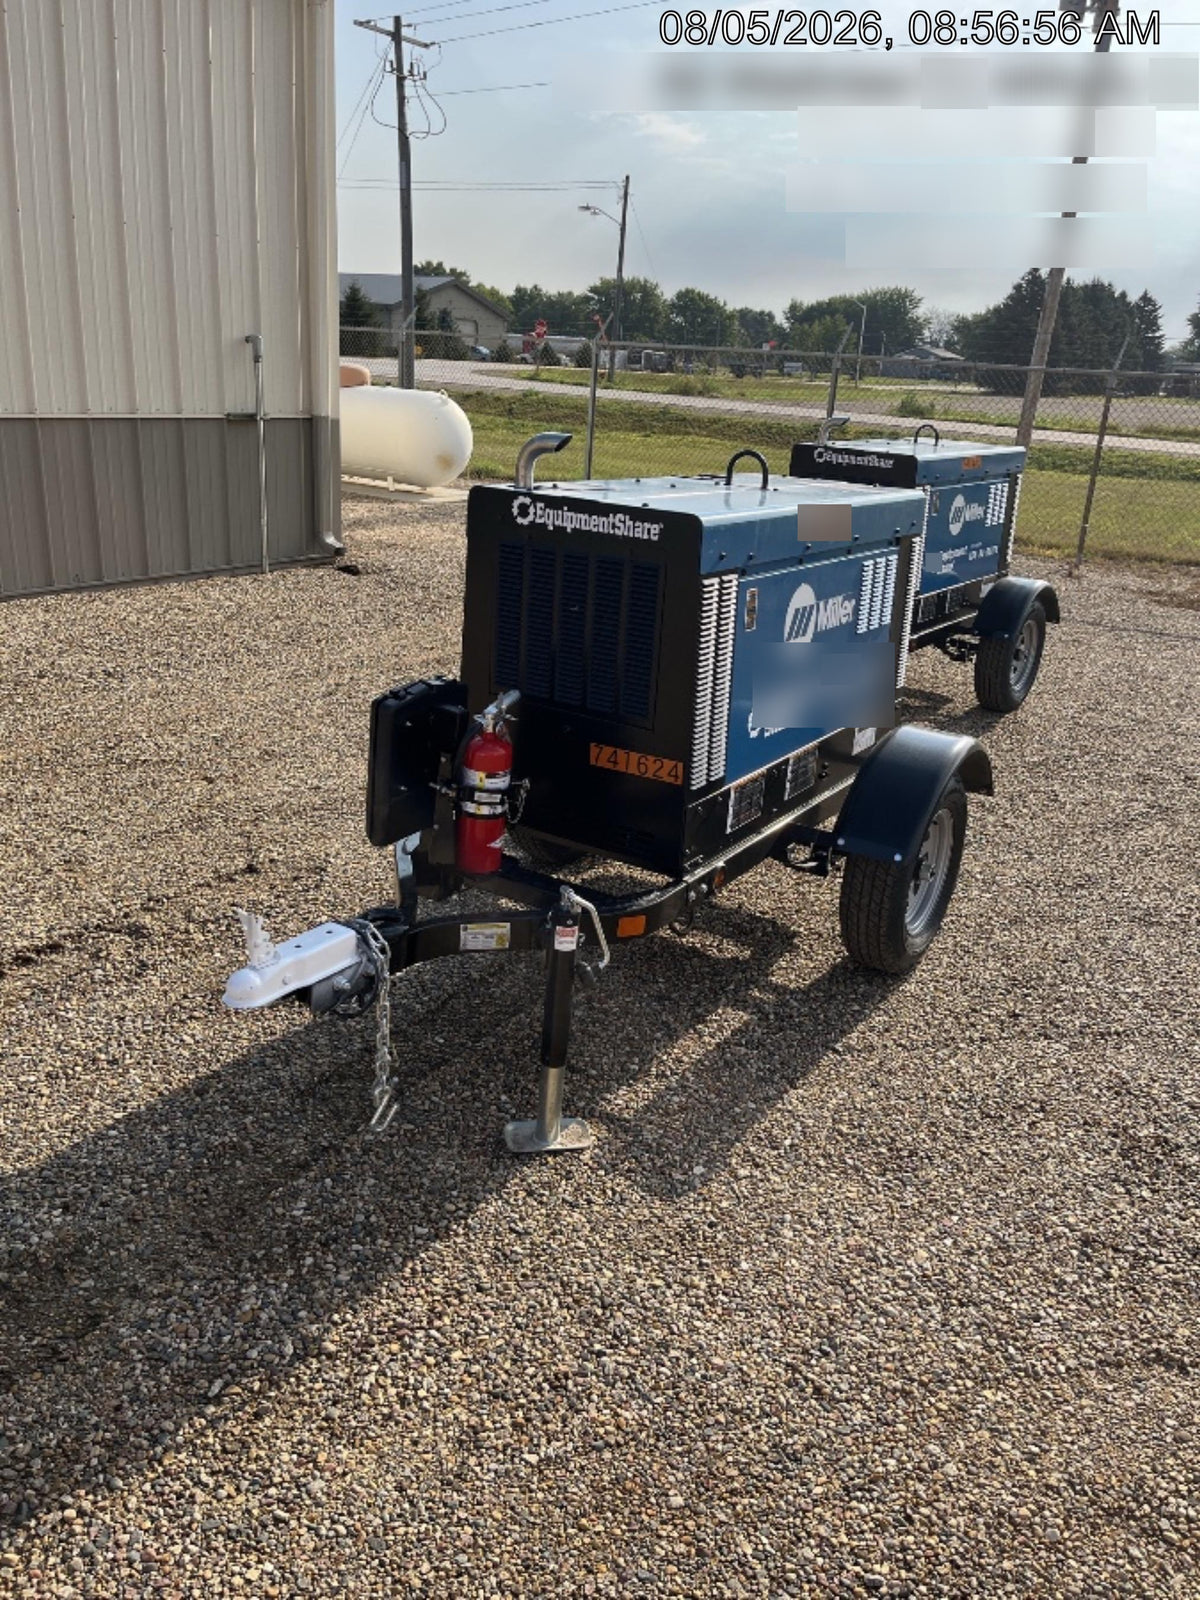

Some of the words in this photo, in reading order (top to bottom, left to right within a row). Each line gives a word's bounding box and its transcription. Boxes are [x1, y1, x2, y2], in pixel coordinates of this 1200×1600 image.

[534, 502, 662, 541] EquipmentShare
[816, 593, 857, 632] Miller
[592, 744, 680, 783] 741624
